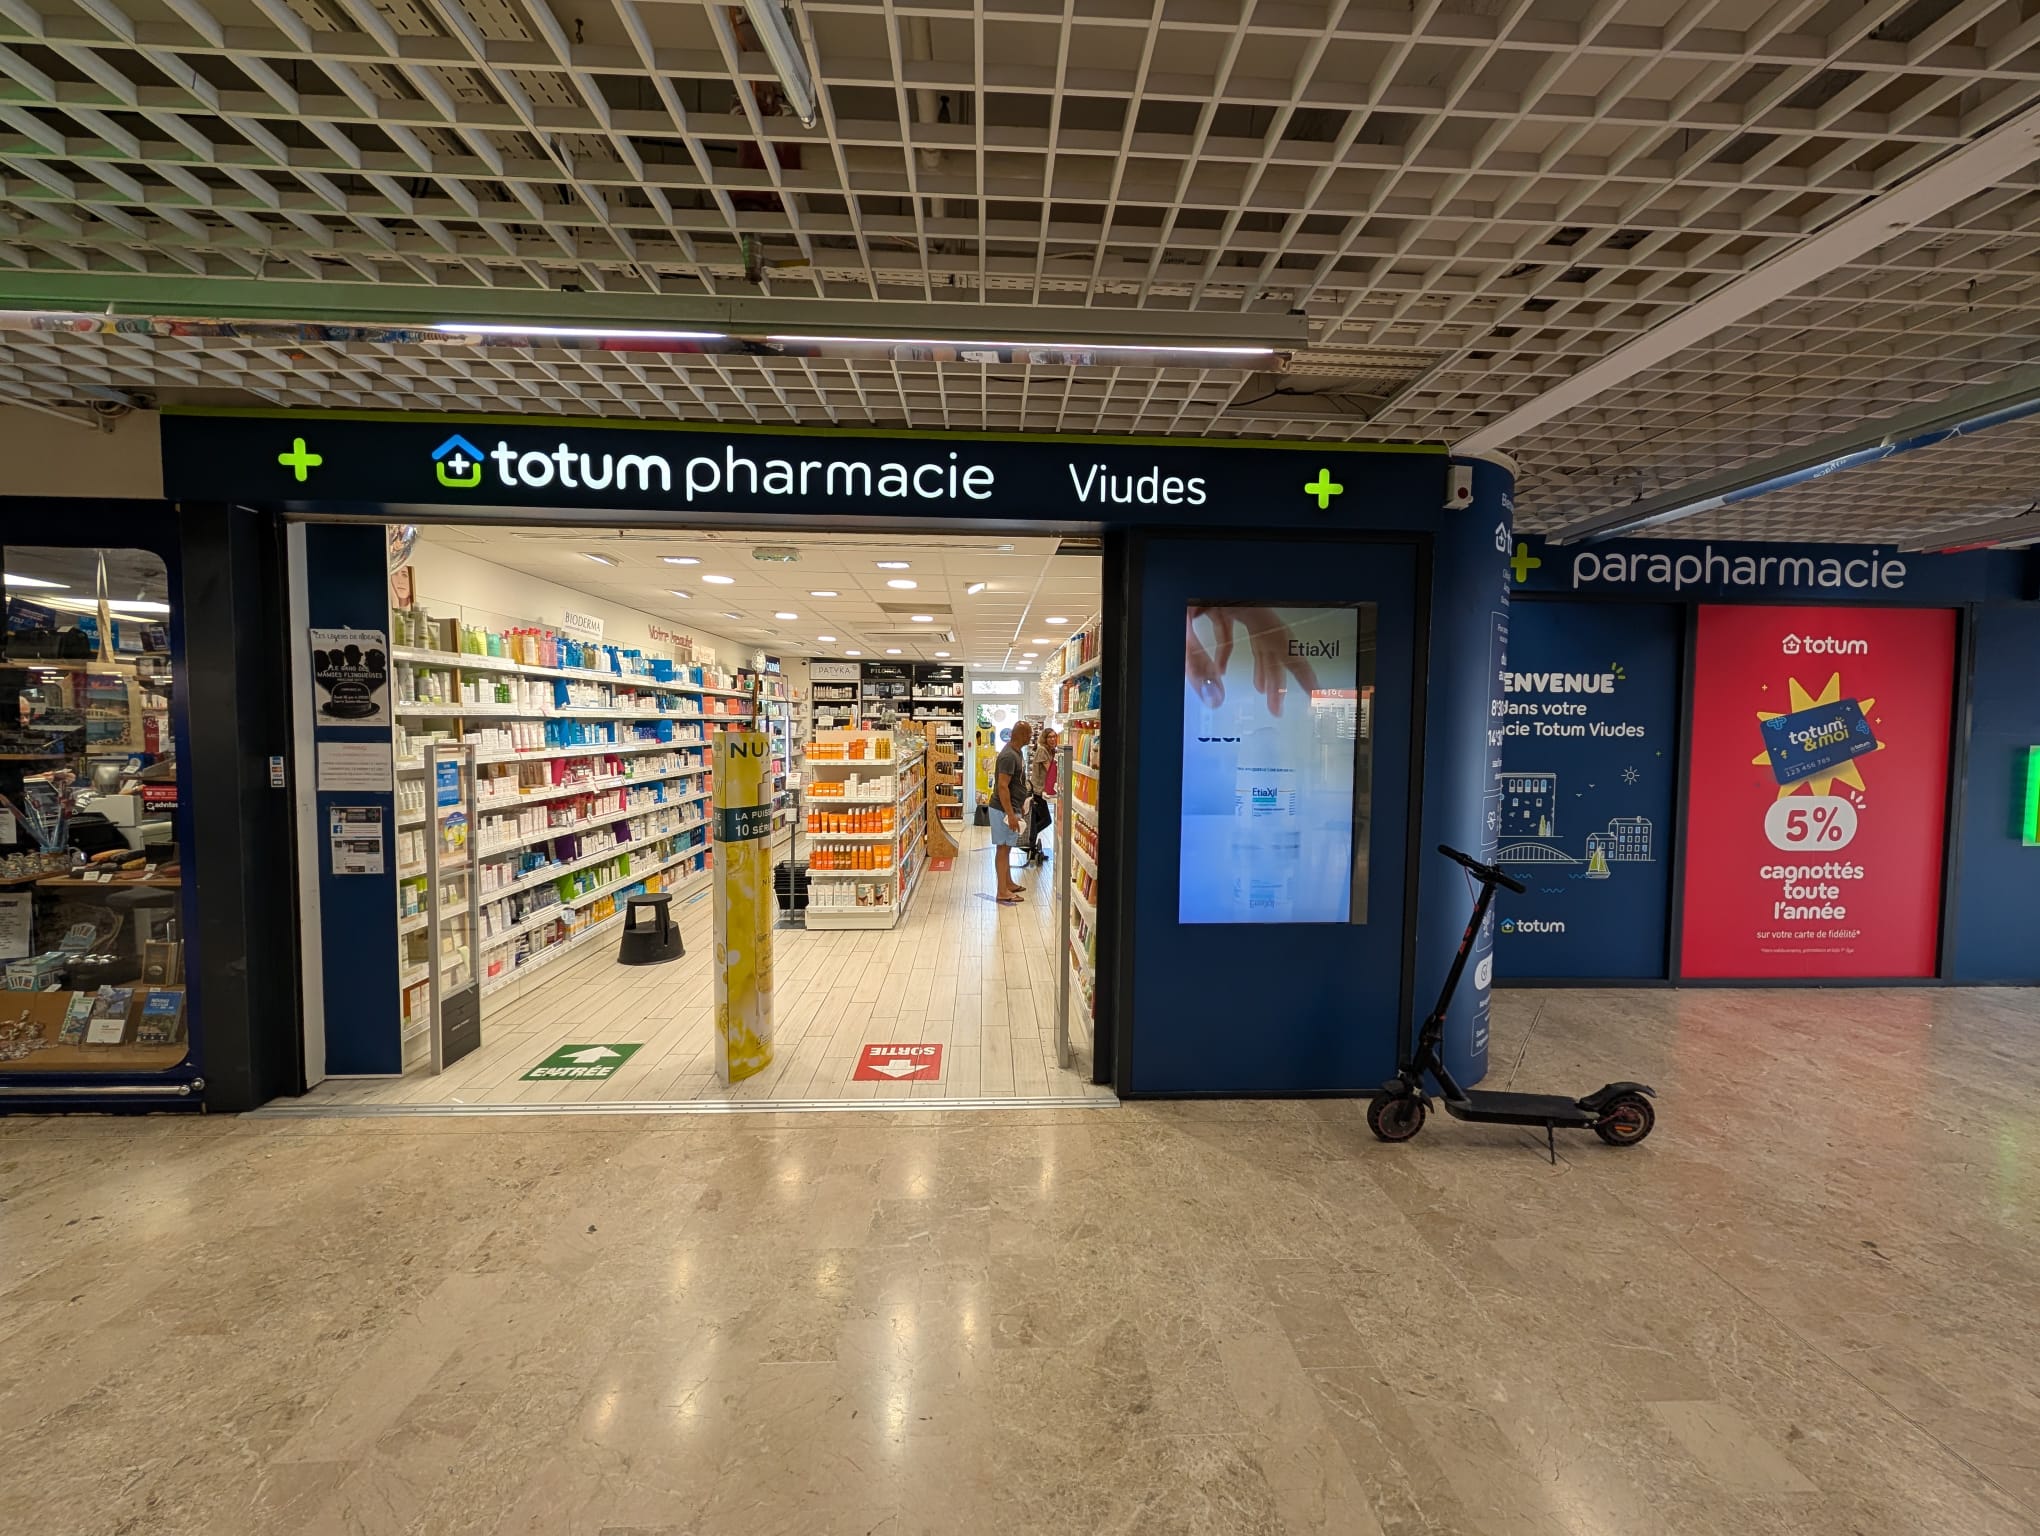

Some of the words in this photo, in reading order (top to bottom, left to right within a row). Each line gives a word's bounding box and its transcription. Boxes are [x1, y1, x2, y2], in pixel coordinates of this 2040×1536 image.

[491, 440, 671, 491] totum
[686, 445, 995, 502] pharmacie
[1068, 462, 1207, 505] Viudes
[1573, 545, 1906, 591] parapharmacie
[565, 611, 600, 631] BIODERMA
[648, 624, 669, 643] Votre
[1288, 639, 1340, 659] EtiaXil
[1803, 635, 1868, 655] totum
[817, 665, 851, 674] PATYKA
[1542, 701, 1587, 716] votre
[1534, 721, 1585, 736] Totum
[1589, 722, 1645, 737] Viudes
[1788, 720, 1844, 745] totum
[1803, 725, 1849, 752] &moi
[1252, 787, 1278, 798] EtiaXil
[735, 813, 748, 821] LA
[1786, 806, 1843, 842] 5%
[735, 824, 750, 837] 10
[1760, 861, 1865, 884] cagnottés
[1783, 880, 1840, 899] toute
[1774, 901, 1847, 920] l'année
[1516, 920, 1565, 933] totum
[1757, 931, 1771, 939] sur
[1772, 930, 1793, 939] votre
[1794, 930, 1815, 939] carte
[1816, 929, 1827, 938] de
[869, 1047, 936, 1056] SORTIE
[528, 1064, 616, 1077] ENTRÉE
